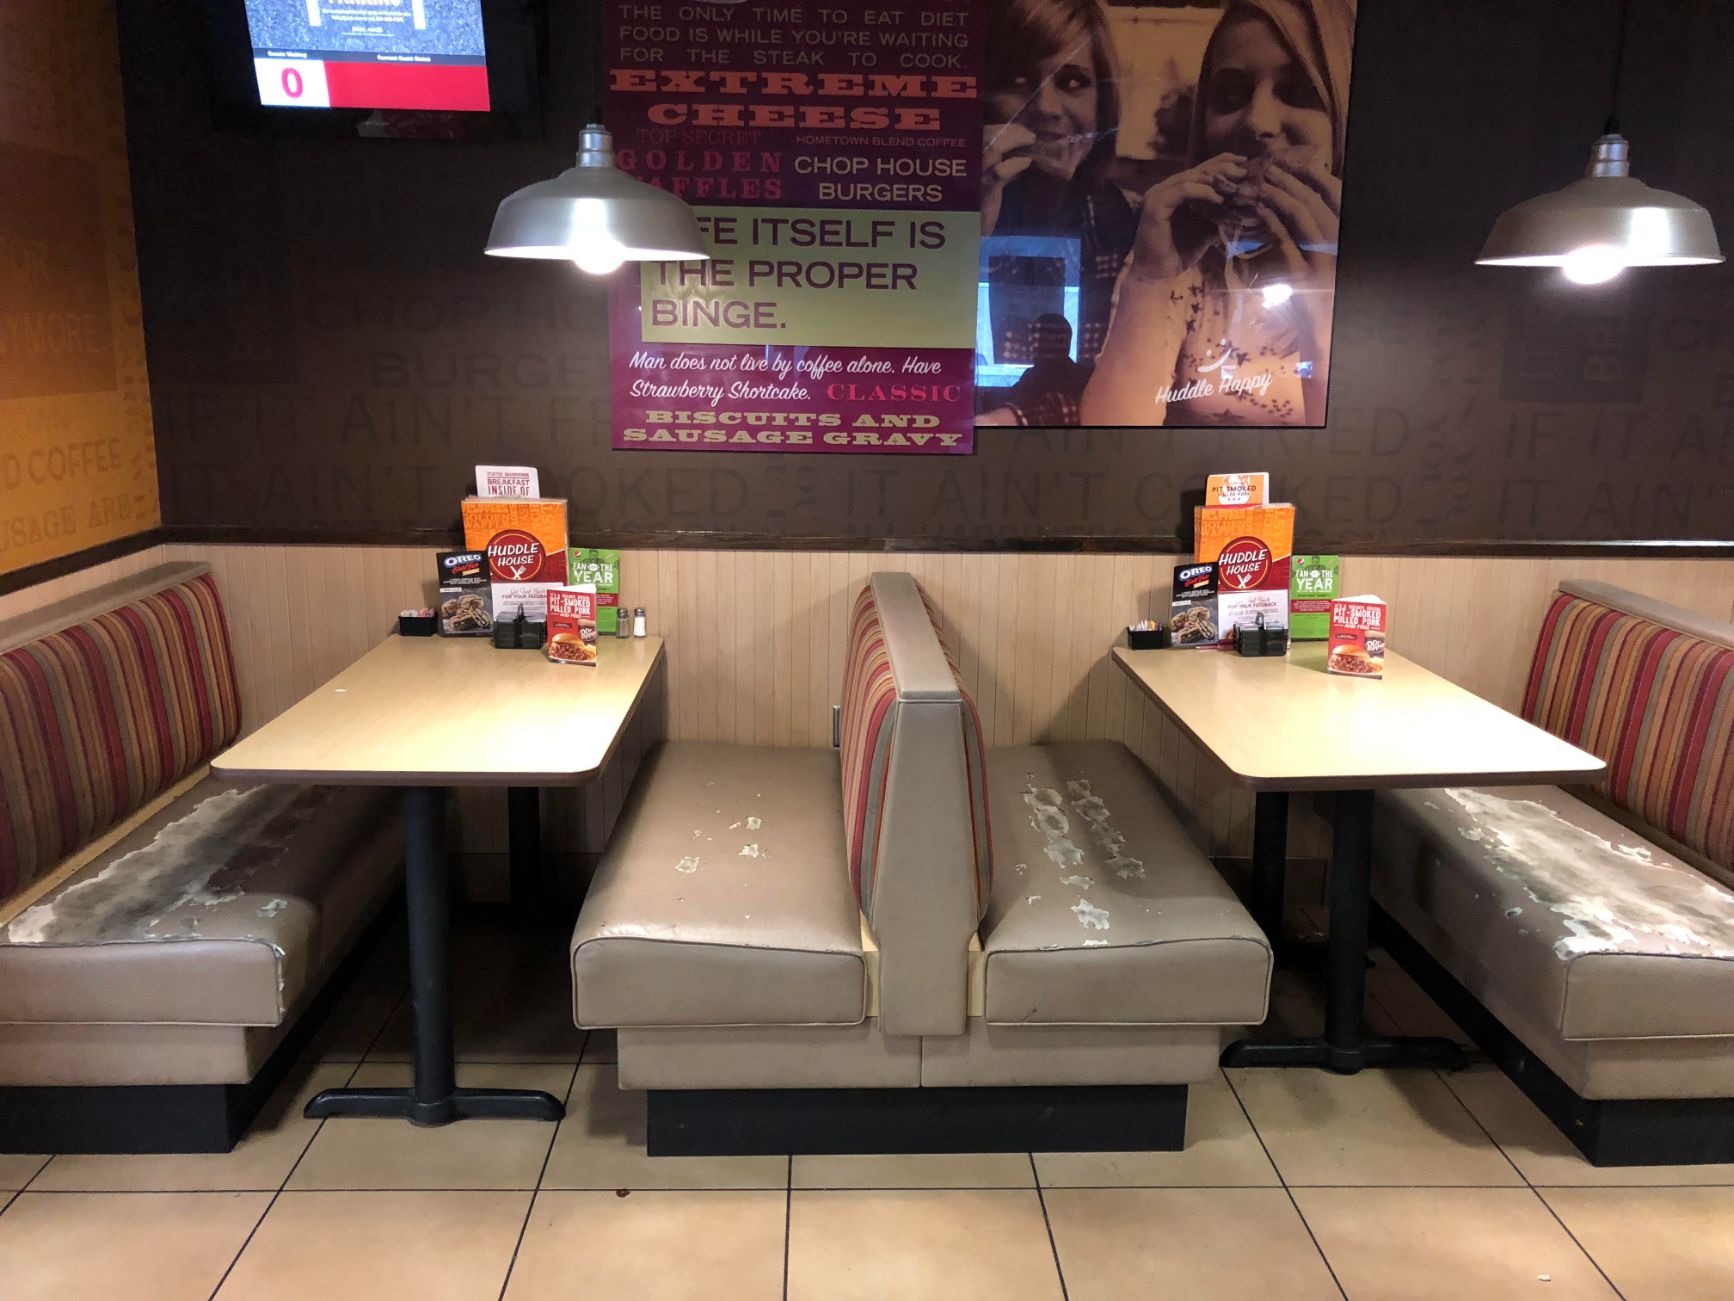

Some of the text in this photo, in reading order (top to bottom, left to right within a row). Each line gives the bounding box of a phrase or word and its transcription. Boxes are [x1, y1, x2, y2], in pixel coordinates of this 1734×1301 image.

[618, 5, 969, 28] THE ONLY TIME TO EAT DIET
[619, 26, 969, 48] FOOD IS WHILE YOU'RE WAITING
[619, 47, 968, 70] FOR THE STEAK TO COOK.
[281, 67, 304, 99] 0
[608, 69, 978, 98] EXTREME
[647, 103, 942, 131] CHEESE
[637, 128, 763, 145] TOP SECRET
[796, 136, 967, 149] HOMETOWN BLEND COFFEE
[616, 148, 783, 173] GOLDEN
[794, 156, 967, 177] CHOP HOUSE
[634, 176, 783, 199] AFFLES
[818, 183, 943, 203] BURGERS
[698, 218, 946, 249] FE ITSELF IS
[652, 260, 918, 290] THE PROPER
[652, 300, 787, 330] BINGE.
[629, 352, 942, 381] Man does not live by coffee alone. Have
[629, 379, 962, 408] Strawberry Shortcake. CLASSIC
[1155, 374, 1273, 405] Huddle Happy
[645, 410, 941, 429] BISCUITS AND
[623, 428, 962, 448] SAUSAGE GRAVY
[487, 478, 530, 487] BREAKFAST
[488, 486, 530, 497] INSIDE OF
[569, 465, 750, 519] OKED
[444, 554, 481, 566] OREO
[487, 543, 540, 558] HUDDLE
[1219, 549, 1268, 566] HUDDLE
[497, 555, 535, 567] HOUSE
[573, 562, 614, 572] FAN THE
[1226, 562, 1262, 576] HOUSE
[573, 571, 614, 584] YEAR
[1179, 565, 1212, 580] OREO
[1296, 570, 1333, 578] FAN THE
[1296, 578, 1333, 591] YEAR
[549, 604, 571, 614] PULLED
[574, 606, 591, 616] PORK
[1333, 606, 1381, 620] PIT-SMOKED
[1333, 615, 1381, 627] PULLED PORK
